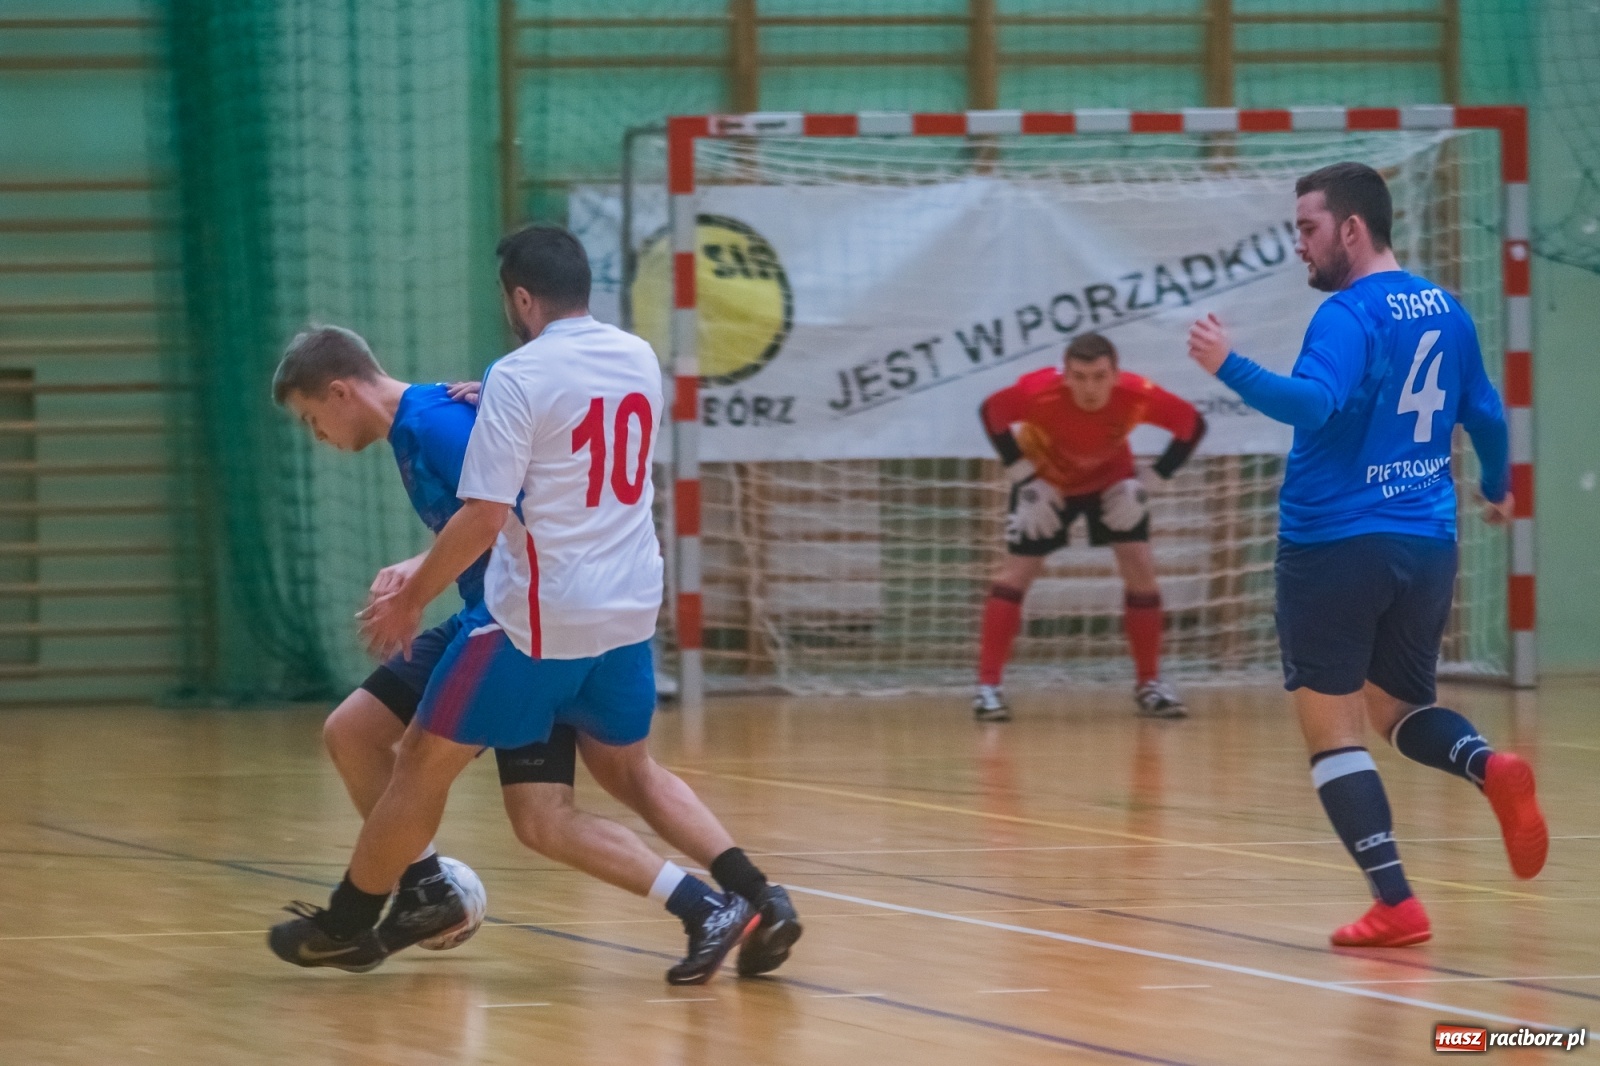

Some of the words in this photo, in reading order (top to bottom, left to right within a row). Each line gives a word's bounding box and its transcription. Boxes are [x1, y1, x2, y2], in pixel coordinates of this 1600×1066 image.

[1386, 288, 1450, 320] START
[829, 336, 941, 411] JEST
[955, 318, 1004, 363] W
[1397, 329, 1447, 443] 4
[571, 391, 653, 508] 10
